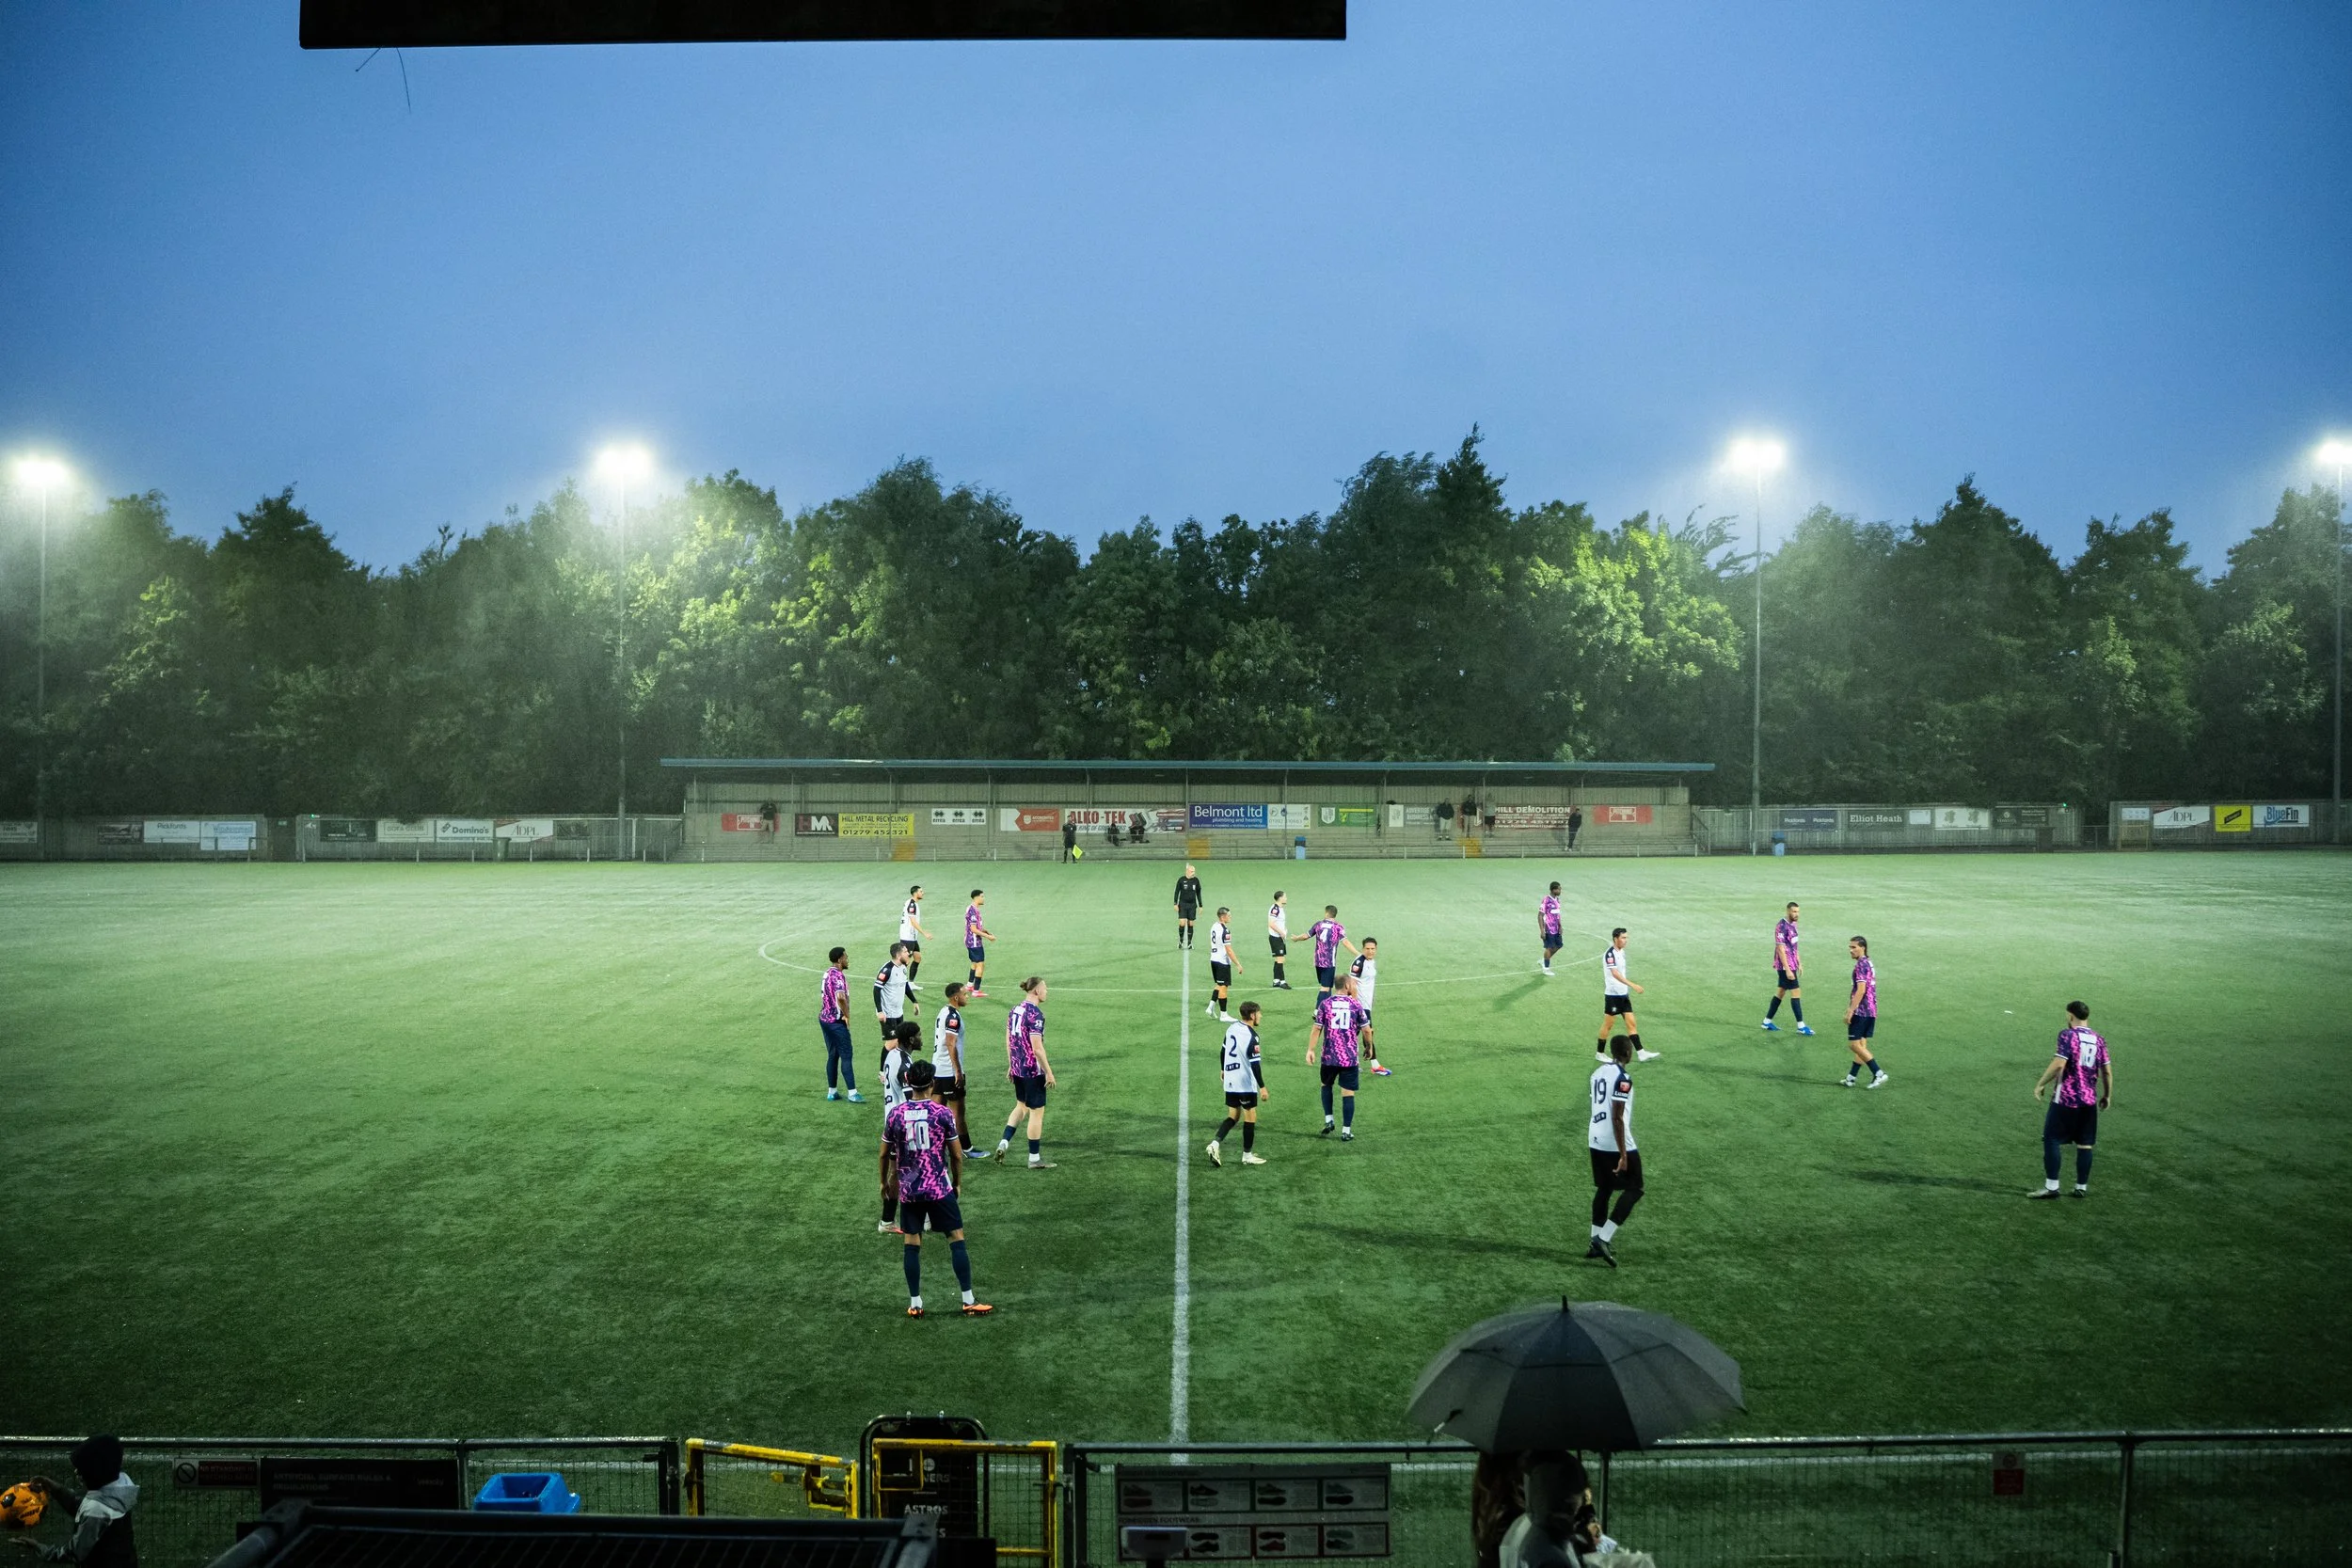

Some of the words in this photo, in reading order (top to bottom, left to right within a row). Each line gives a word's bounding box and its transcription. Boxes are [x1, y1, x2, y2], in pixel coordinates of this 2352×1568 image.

[1195, 805, 1245, 817] Belmont
[1248, 805, 1263, 817] ltd
[2168, 810, 2196, 822] ADPL
[2266, 806, 2299, 820] BlueFin
[1850, 815, 1873, 823] Elliot
[1876, 815, 1902, 823] Heath
[452, 825, 489, 834] Domino's
[1319, 928, 1328, 942] 4
[1011, 1014, 1023, 1037] 14
[1331, 1008, 1351, 1029] 20
[1229, 1035, 1238, 1057] 2
[2079, 1042, 2097, 1068] 18
[1594, 1078, 1607, 1104] 19
[906, 1120, 930, 1150] 10
[904, 1504, 948, 1514] ASTROS
